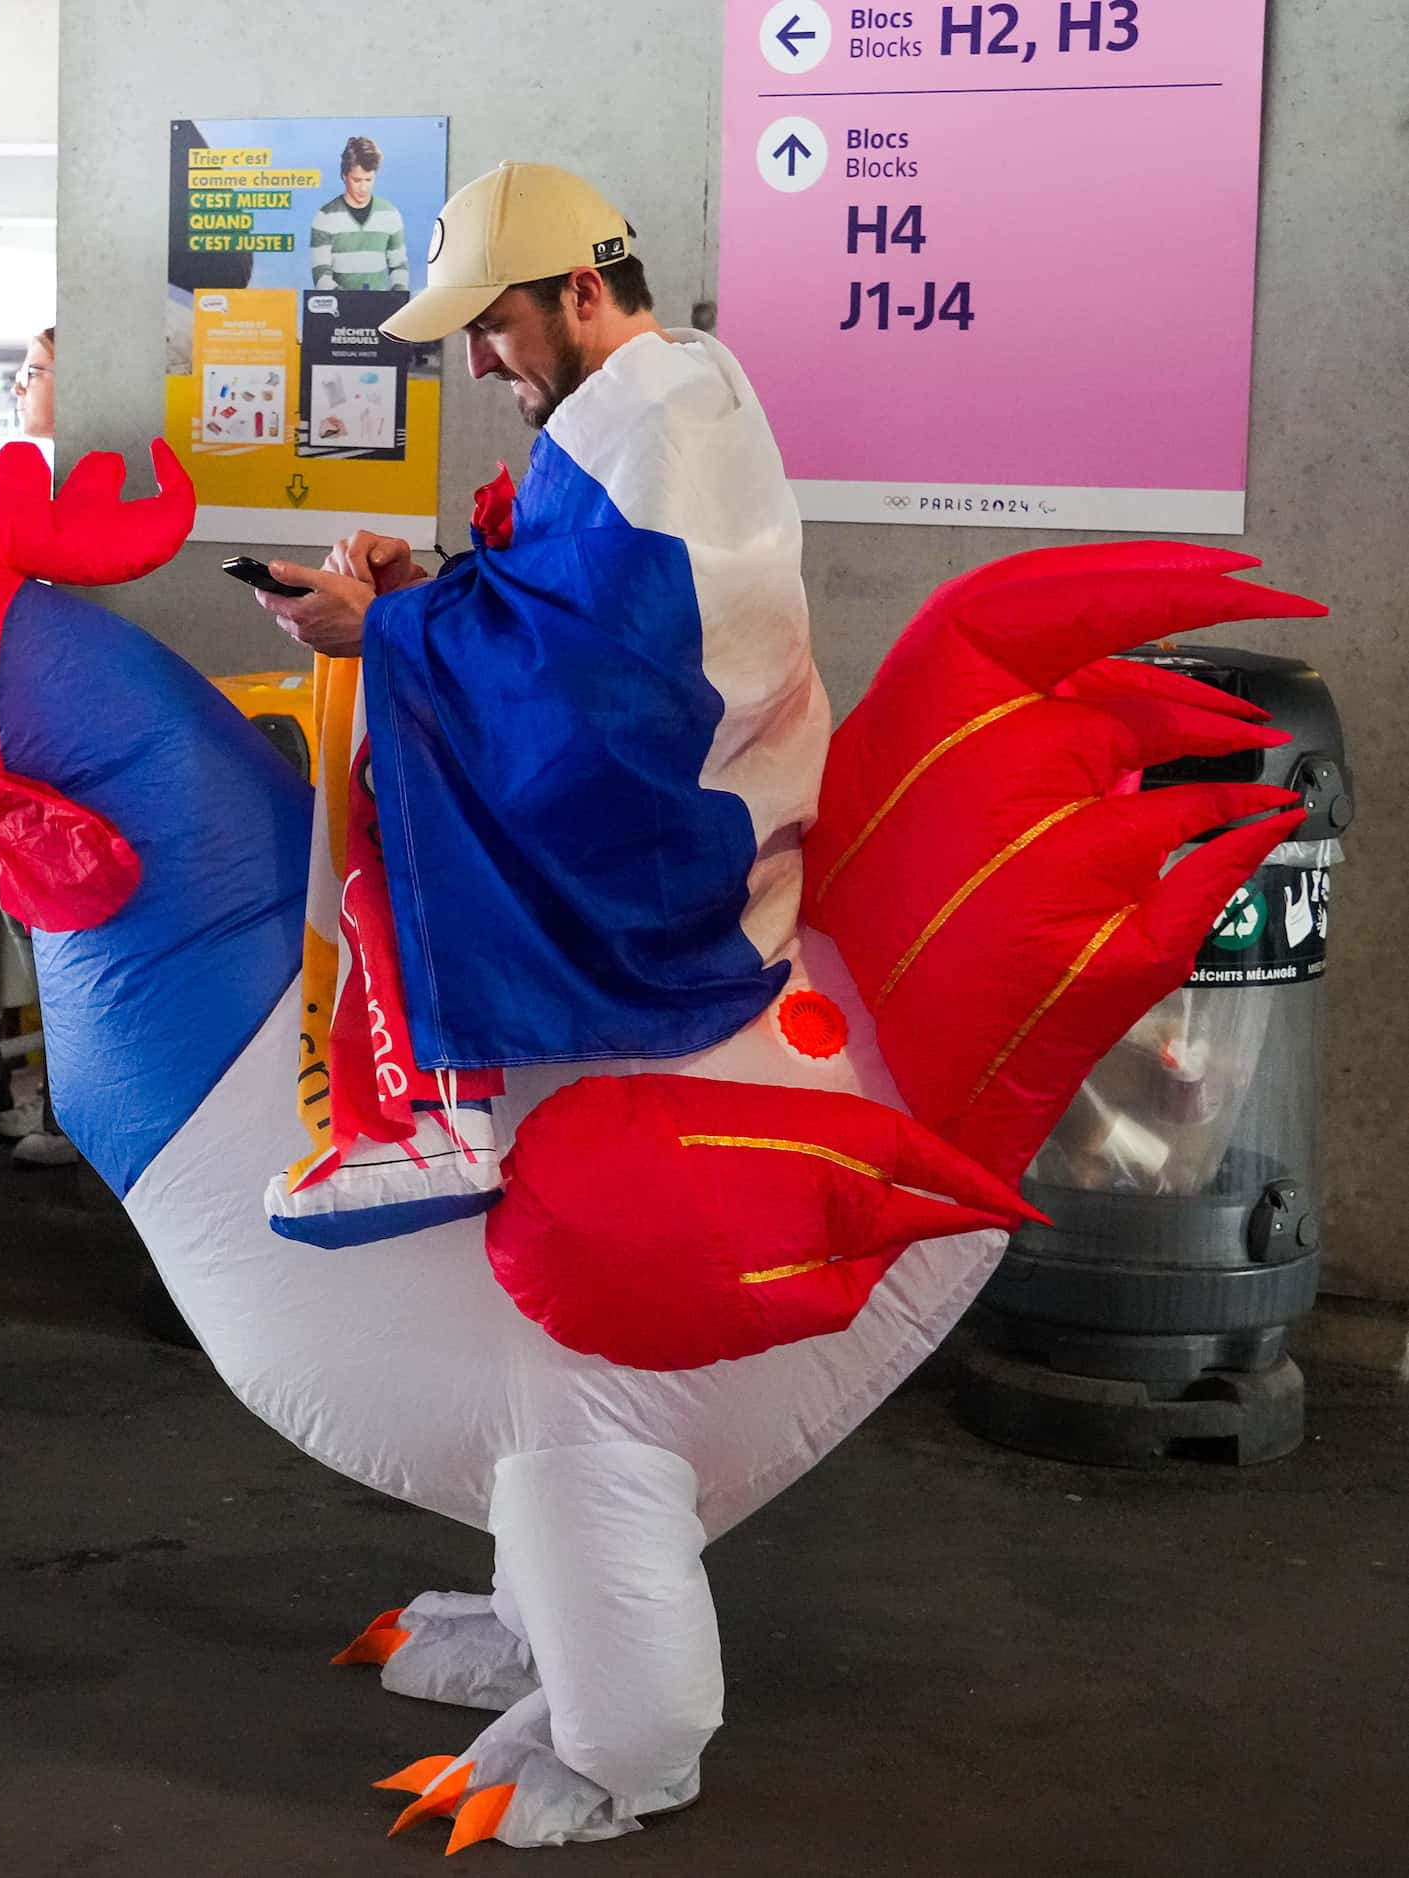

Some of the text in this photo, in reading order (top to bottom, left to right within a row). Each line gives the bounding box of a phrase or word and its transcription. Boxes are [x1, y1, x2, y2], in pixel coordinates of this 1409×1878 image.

[850, 8, 913, 29] Blocs
[939, 0, 1139, 63] H2, H3
[849, 36, 922, 58] Blocks
[847, 128, 909, 149] Blocs
[192, 150, 268, 165] Trier c'est
[846, 156, 919, 178] Blocks
[192, 174, 247, 186] comme
[190, 192, 290, 208] C'EST MIEUX
[190, 214, 252, 229] QUAND
[847, 205, 926, 254] H4
[190, 235, 232, 251] C'EST
[236, 235, 282, 250] JUSTE
[839, 281, 975, 331] J1-J4
[920, 497, 1029, 512] PARIS 2024
[1246, 965, 1297, 981] MÉLANGÉS
